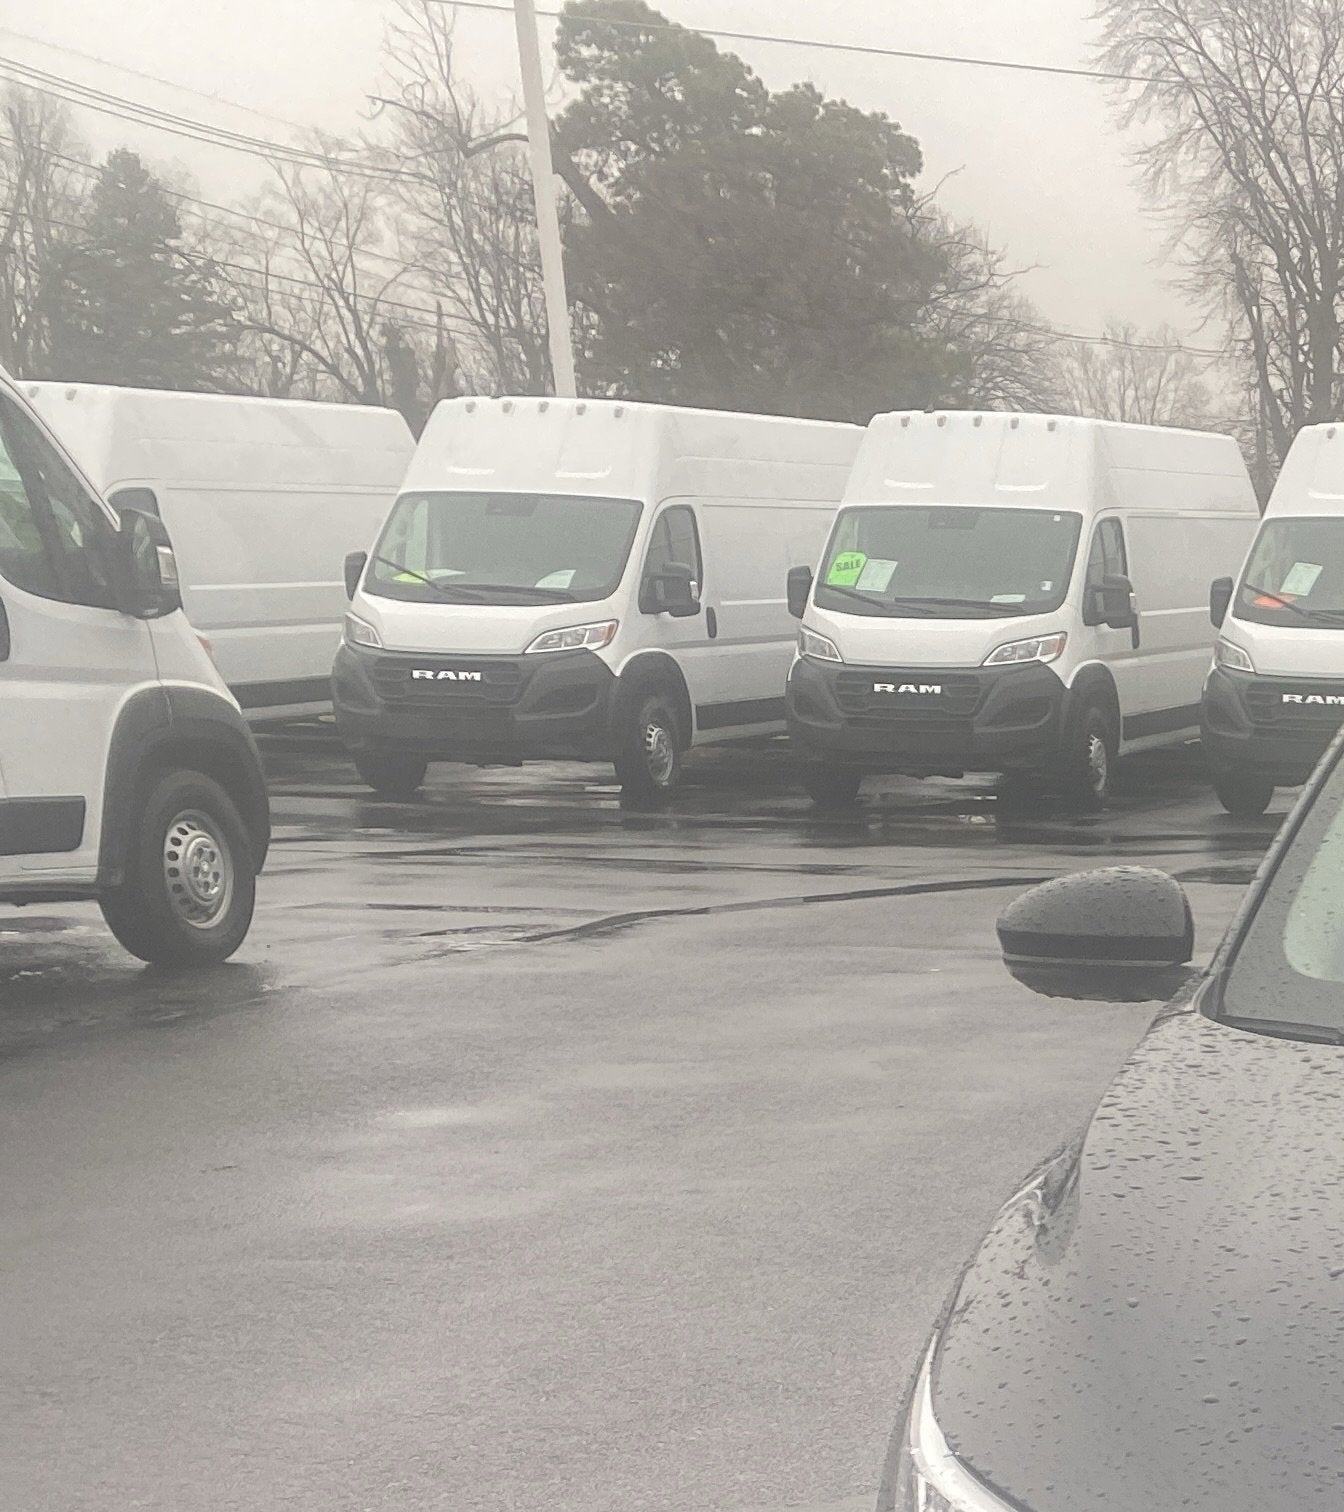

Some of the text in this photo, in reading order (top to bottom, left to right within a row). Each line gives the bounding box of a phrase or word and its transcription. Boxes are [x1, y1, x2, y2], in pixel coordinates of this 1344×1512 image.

[836, 559, 862, 571] SALE
[412, 669, 481, 681] RAM
[873, 683, 942, 695] RAM
